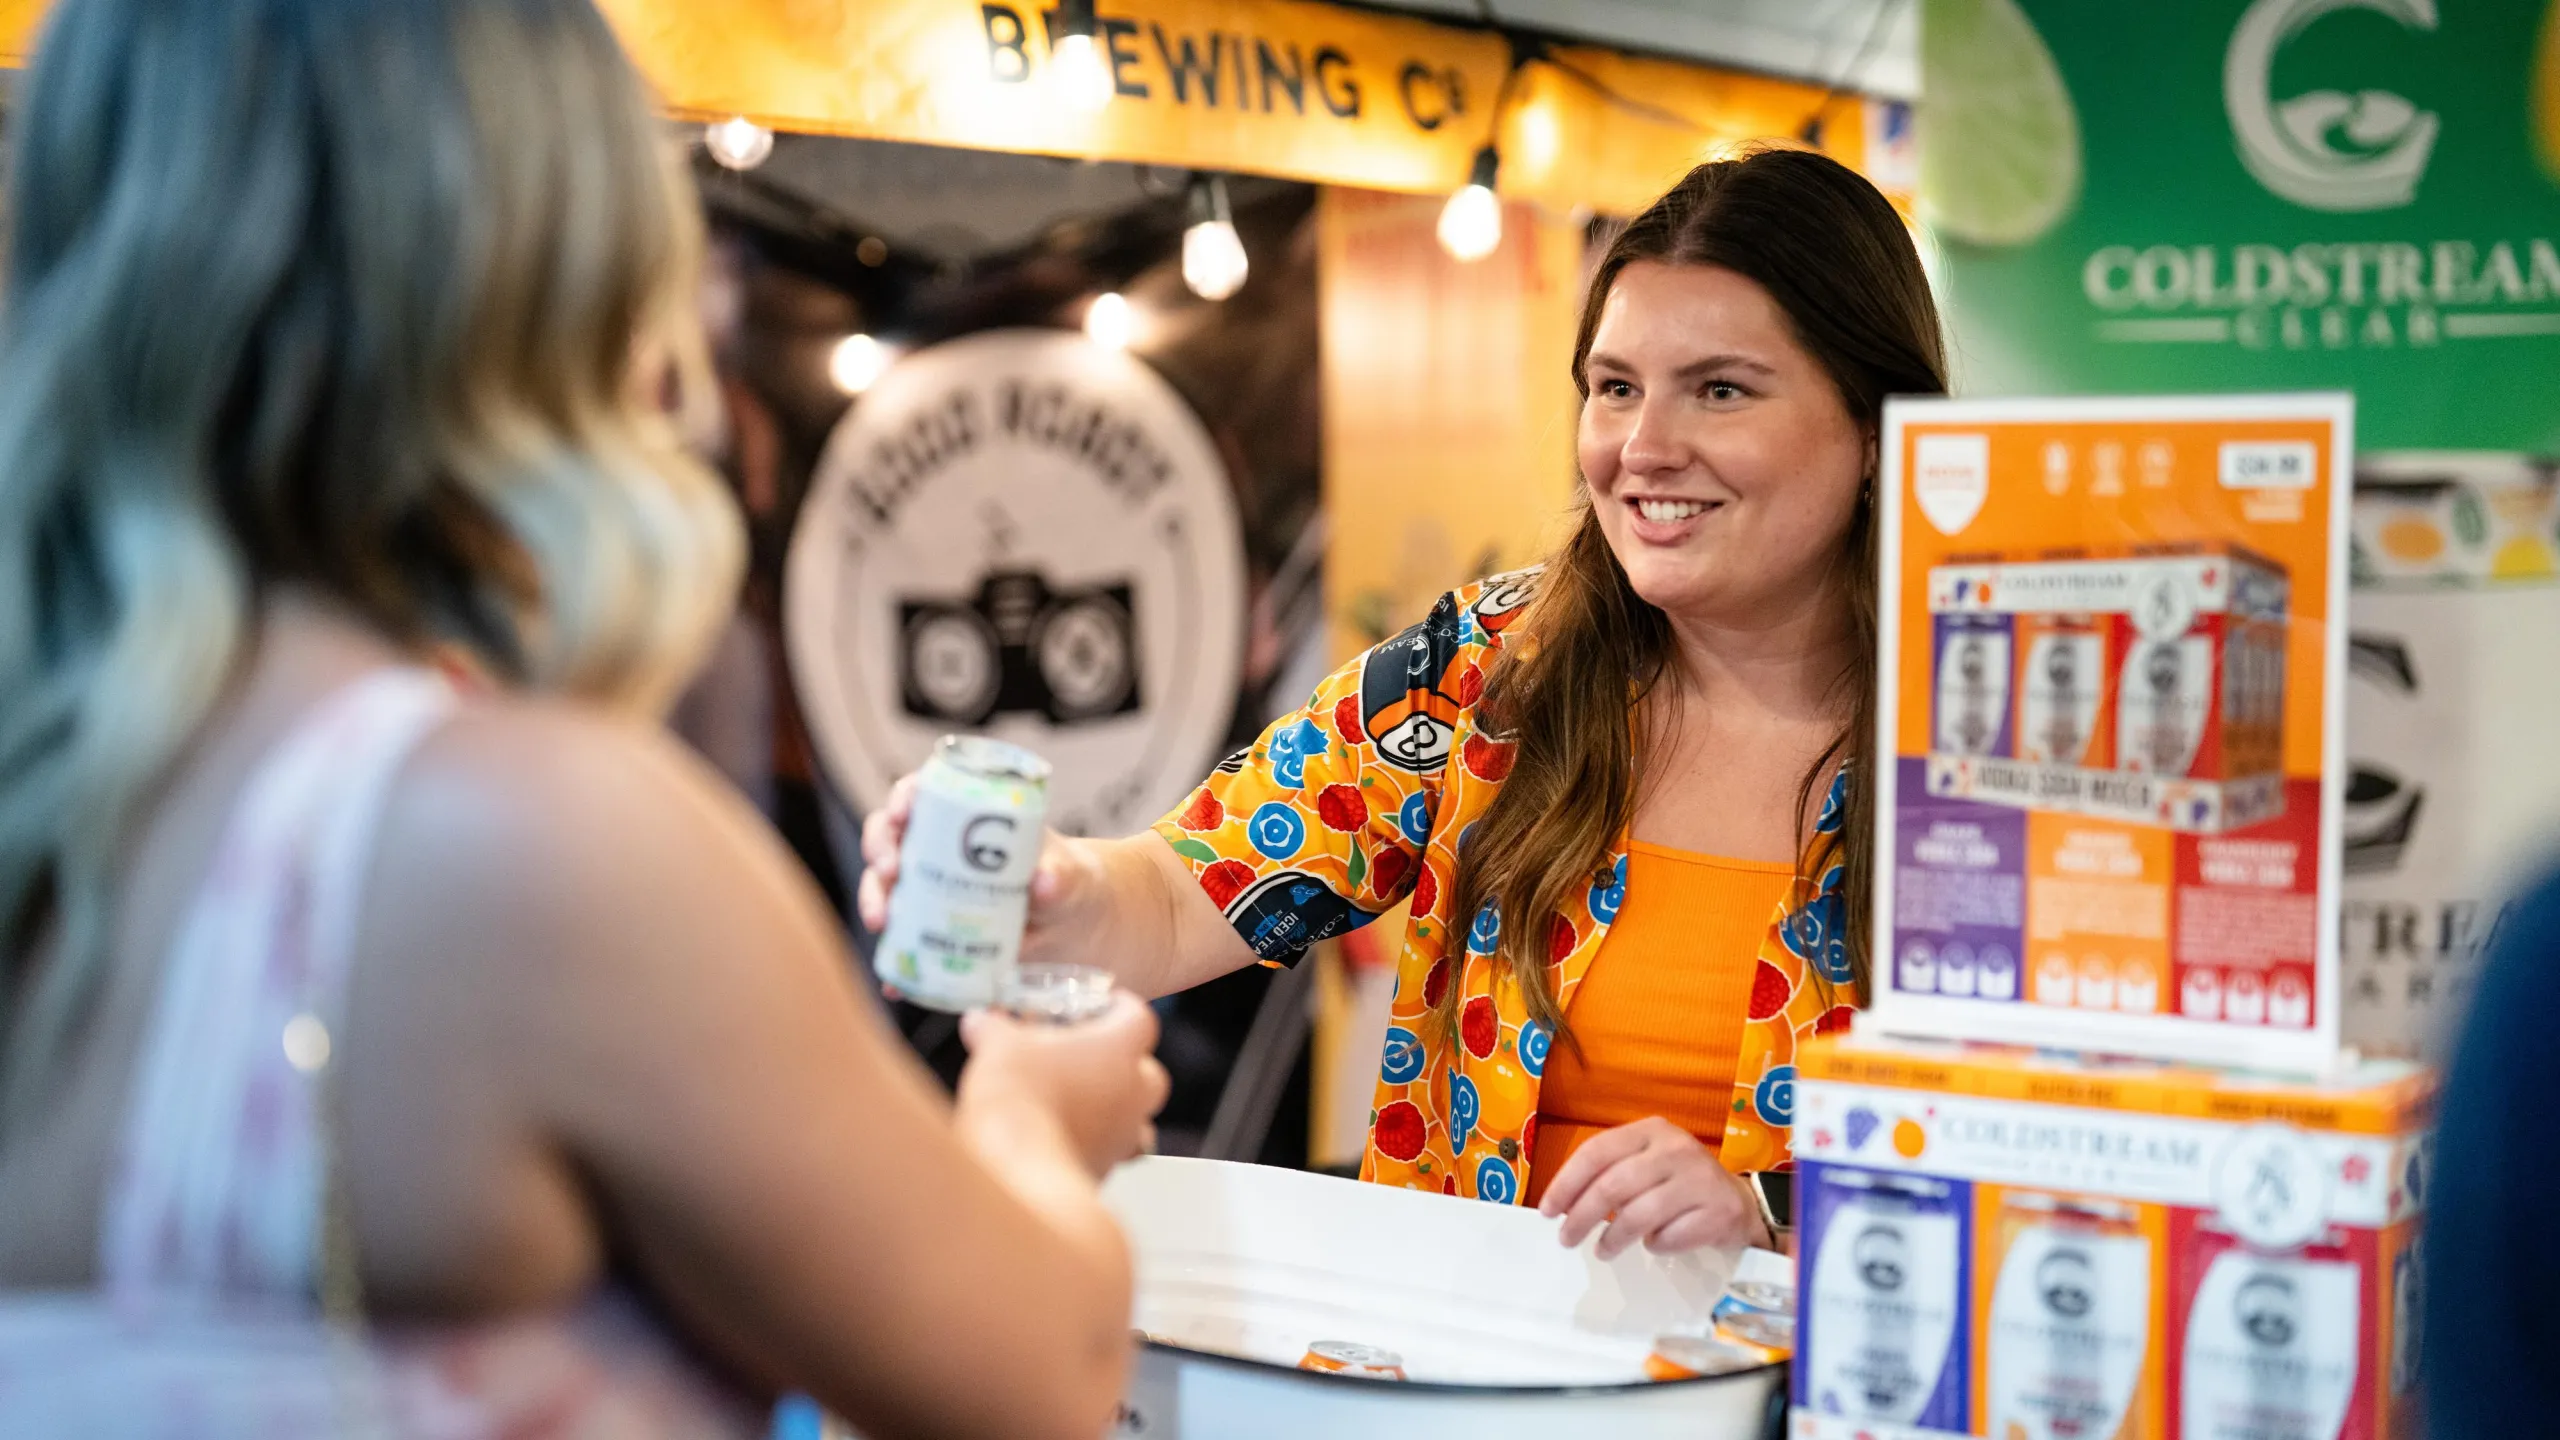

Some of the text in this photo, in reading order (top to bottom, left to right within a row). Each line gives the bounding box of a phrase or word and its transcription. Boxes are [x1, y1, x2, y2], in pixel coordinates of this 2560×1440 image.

[981, 4, 1360, 118] BEWING
[1272, 912, 1299, 937] ICED
[1254, 935, 1275, 955] TEA
